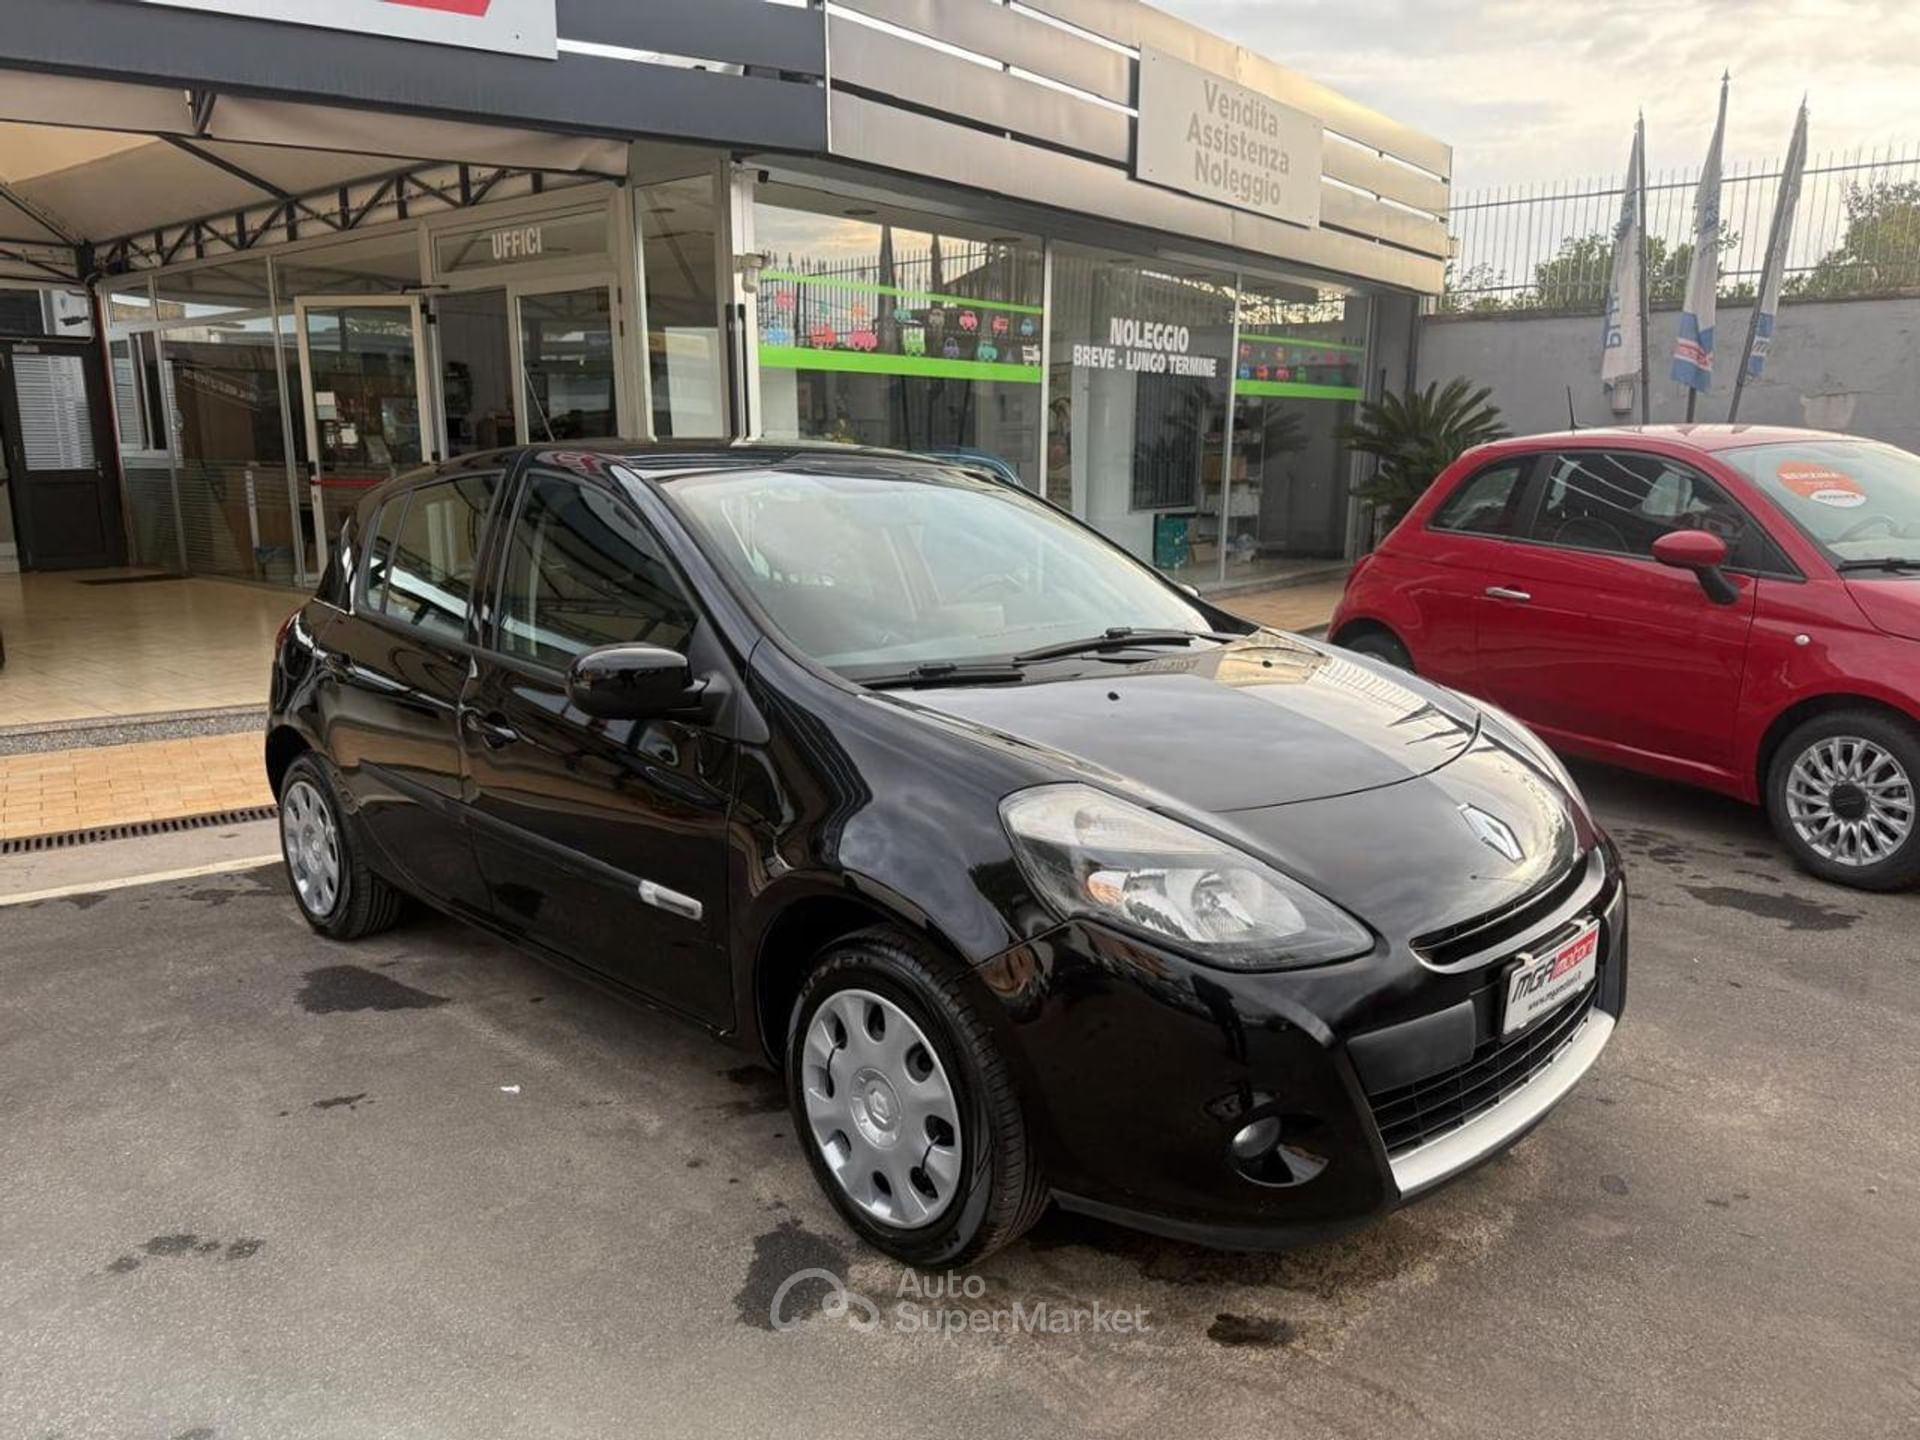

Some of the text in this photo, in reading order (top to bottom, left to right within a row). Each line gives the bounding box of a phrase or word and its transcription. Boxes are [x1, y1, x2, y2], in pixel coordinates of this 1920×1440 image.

[1203, 79, 1278, 137] Vendita
[1187, 112, 1289, 174] Assistenza
[1194, 149, 1281, 205] Noleggio
[492, 227, 542, 259] UFFICI
[1110, 317, 1190, 353] NOLEGGIO
[1073, 344, 1116, 369] BREVE
[1126, 351, 1166, 373] LUNGO
[1168, 354, 1217, 377] TERMINE
